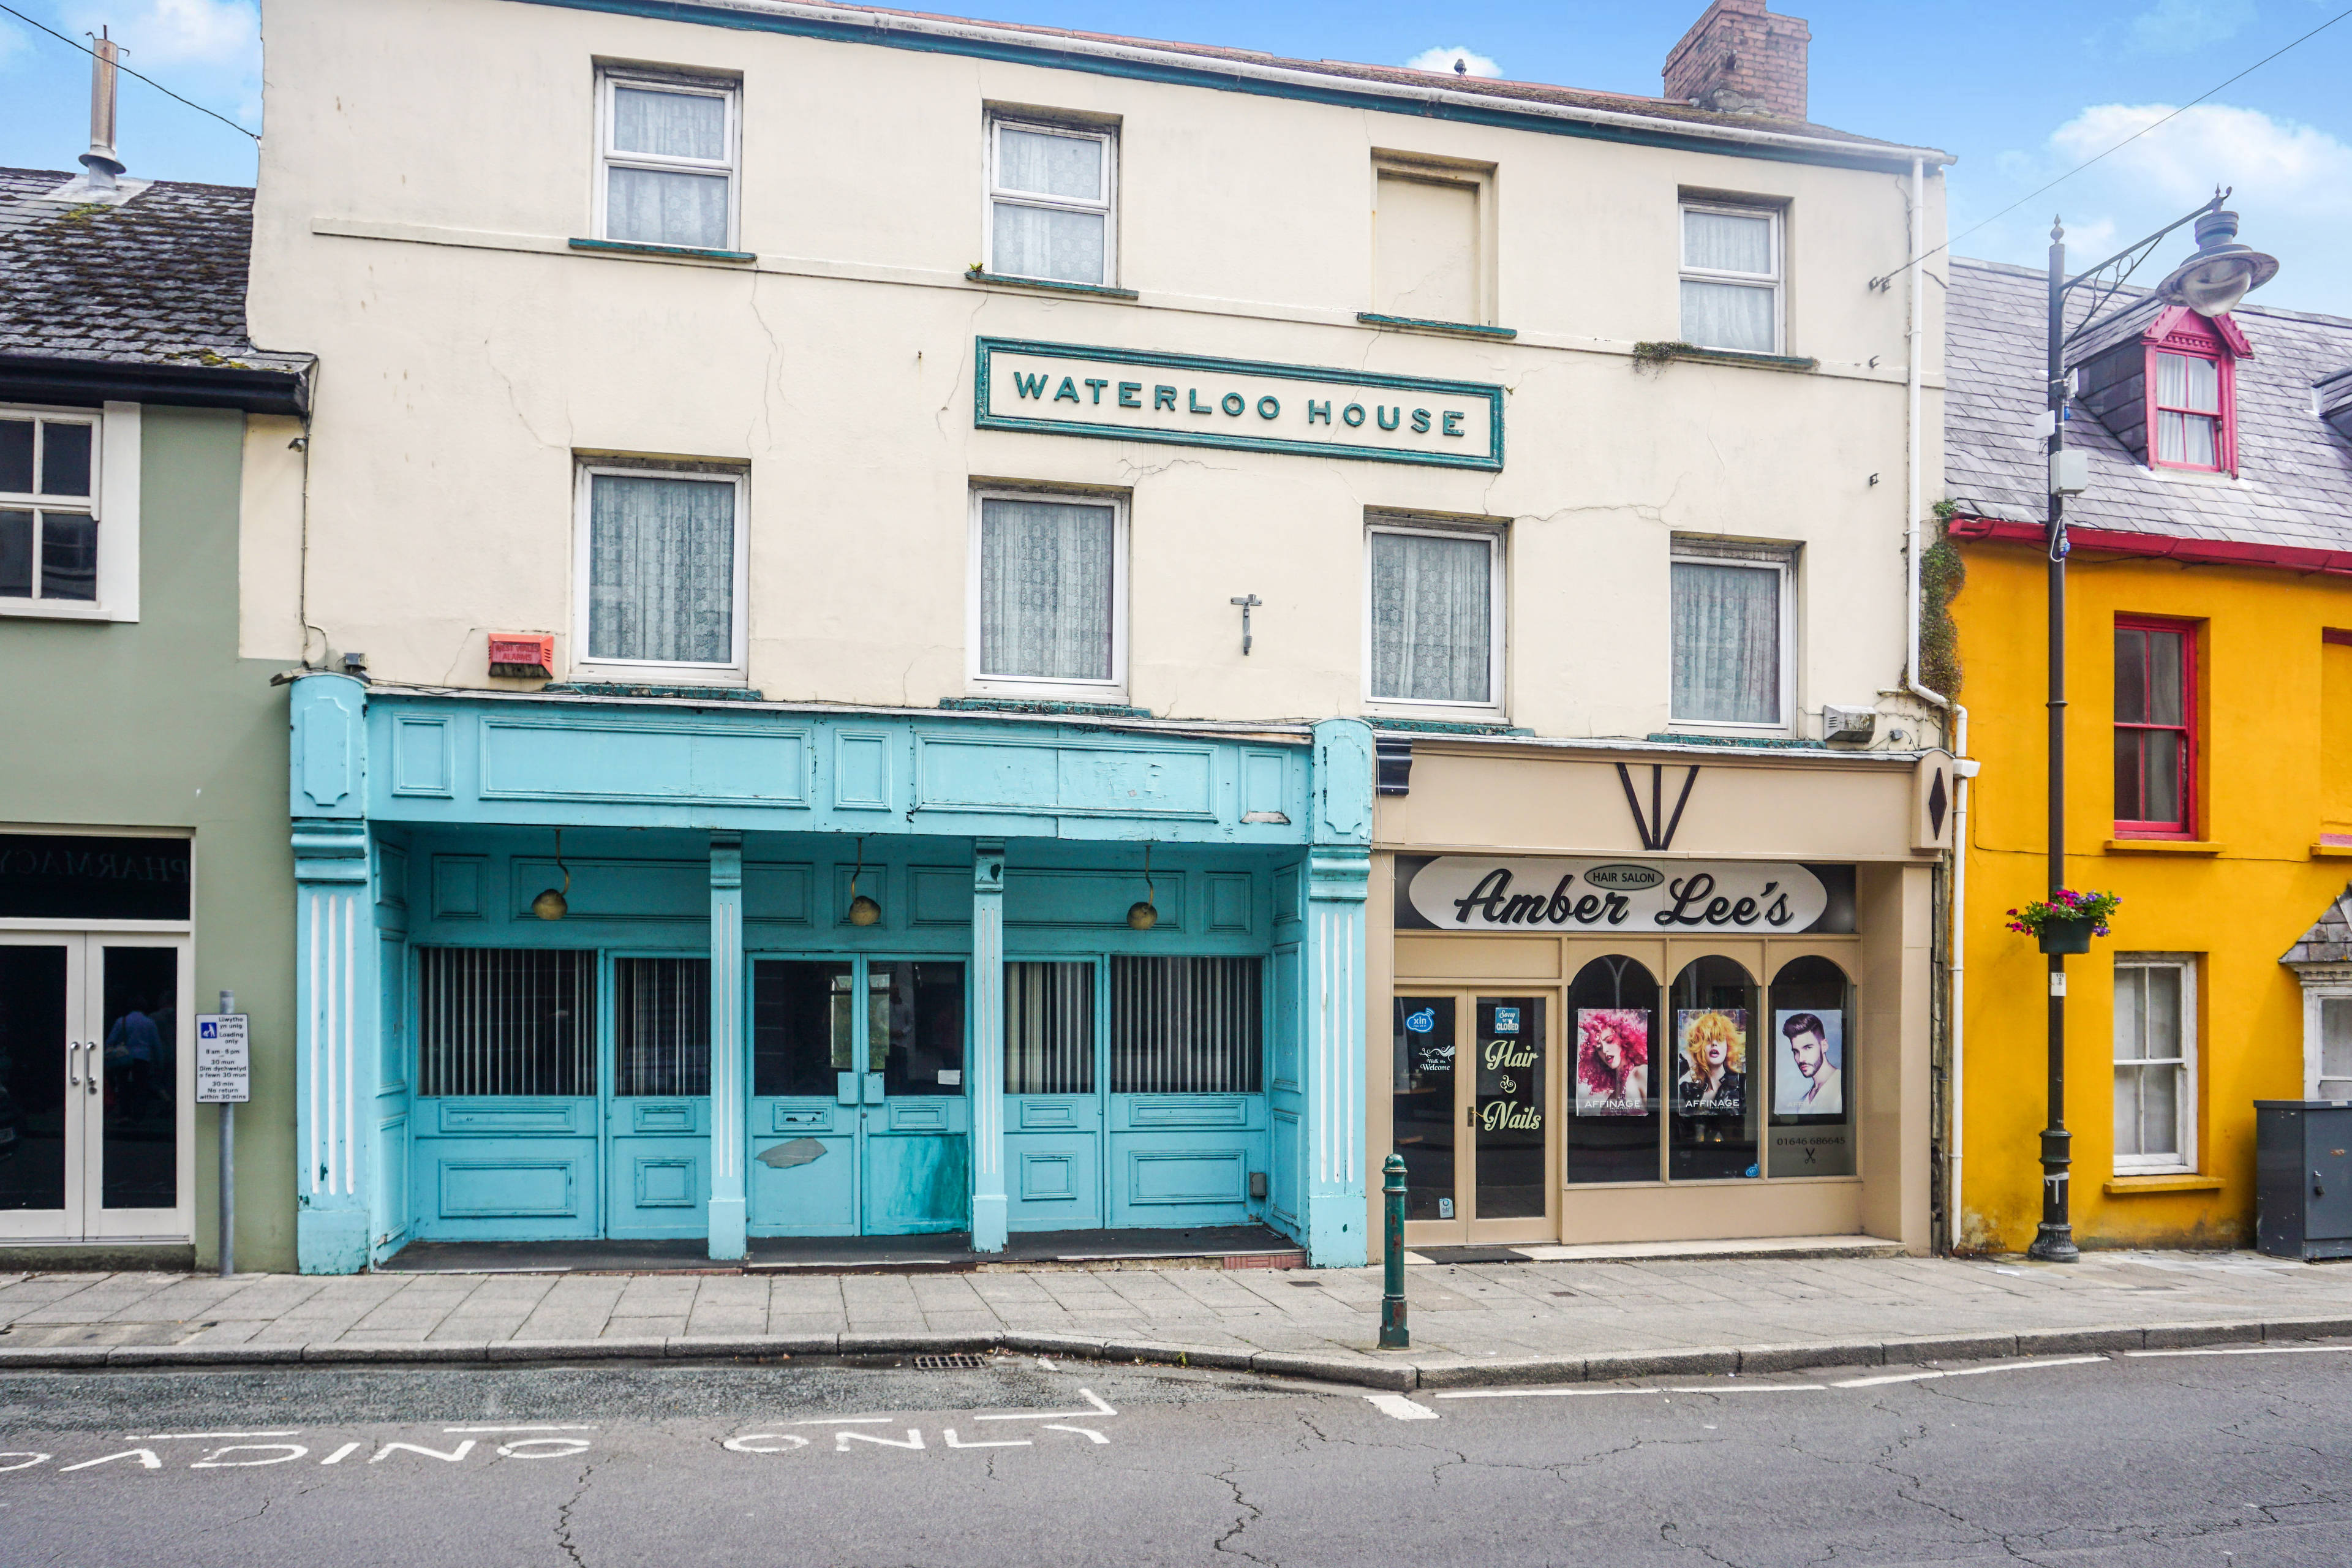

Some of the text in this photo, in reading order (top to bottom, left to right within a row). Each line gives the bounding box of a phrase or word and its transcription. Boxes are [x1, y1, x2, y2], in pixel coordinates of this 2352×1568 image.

[1013, 371, 1465, 437] WATERLOO HOUSE
[1593, 872, 1654, 883] HAIR SALON
[1453, 869, 1795, 926] Amber Lee's
[1485, 1040, 1539, 1070] Hair
[1483, 1101, 1542, 1131] Nails
[1585, 1099, 1641, 1108] AFFINAGE
[1686, 1099, 1740, 1108] AFFINAGE
